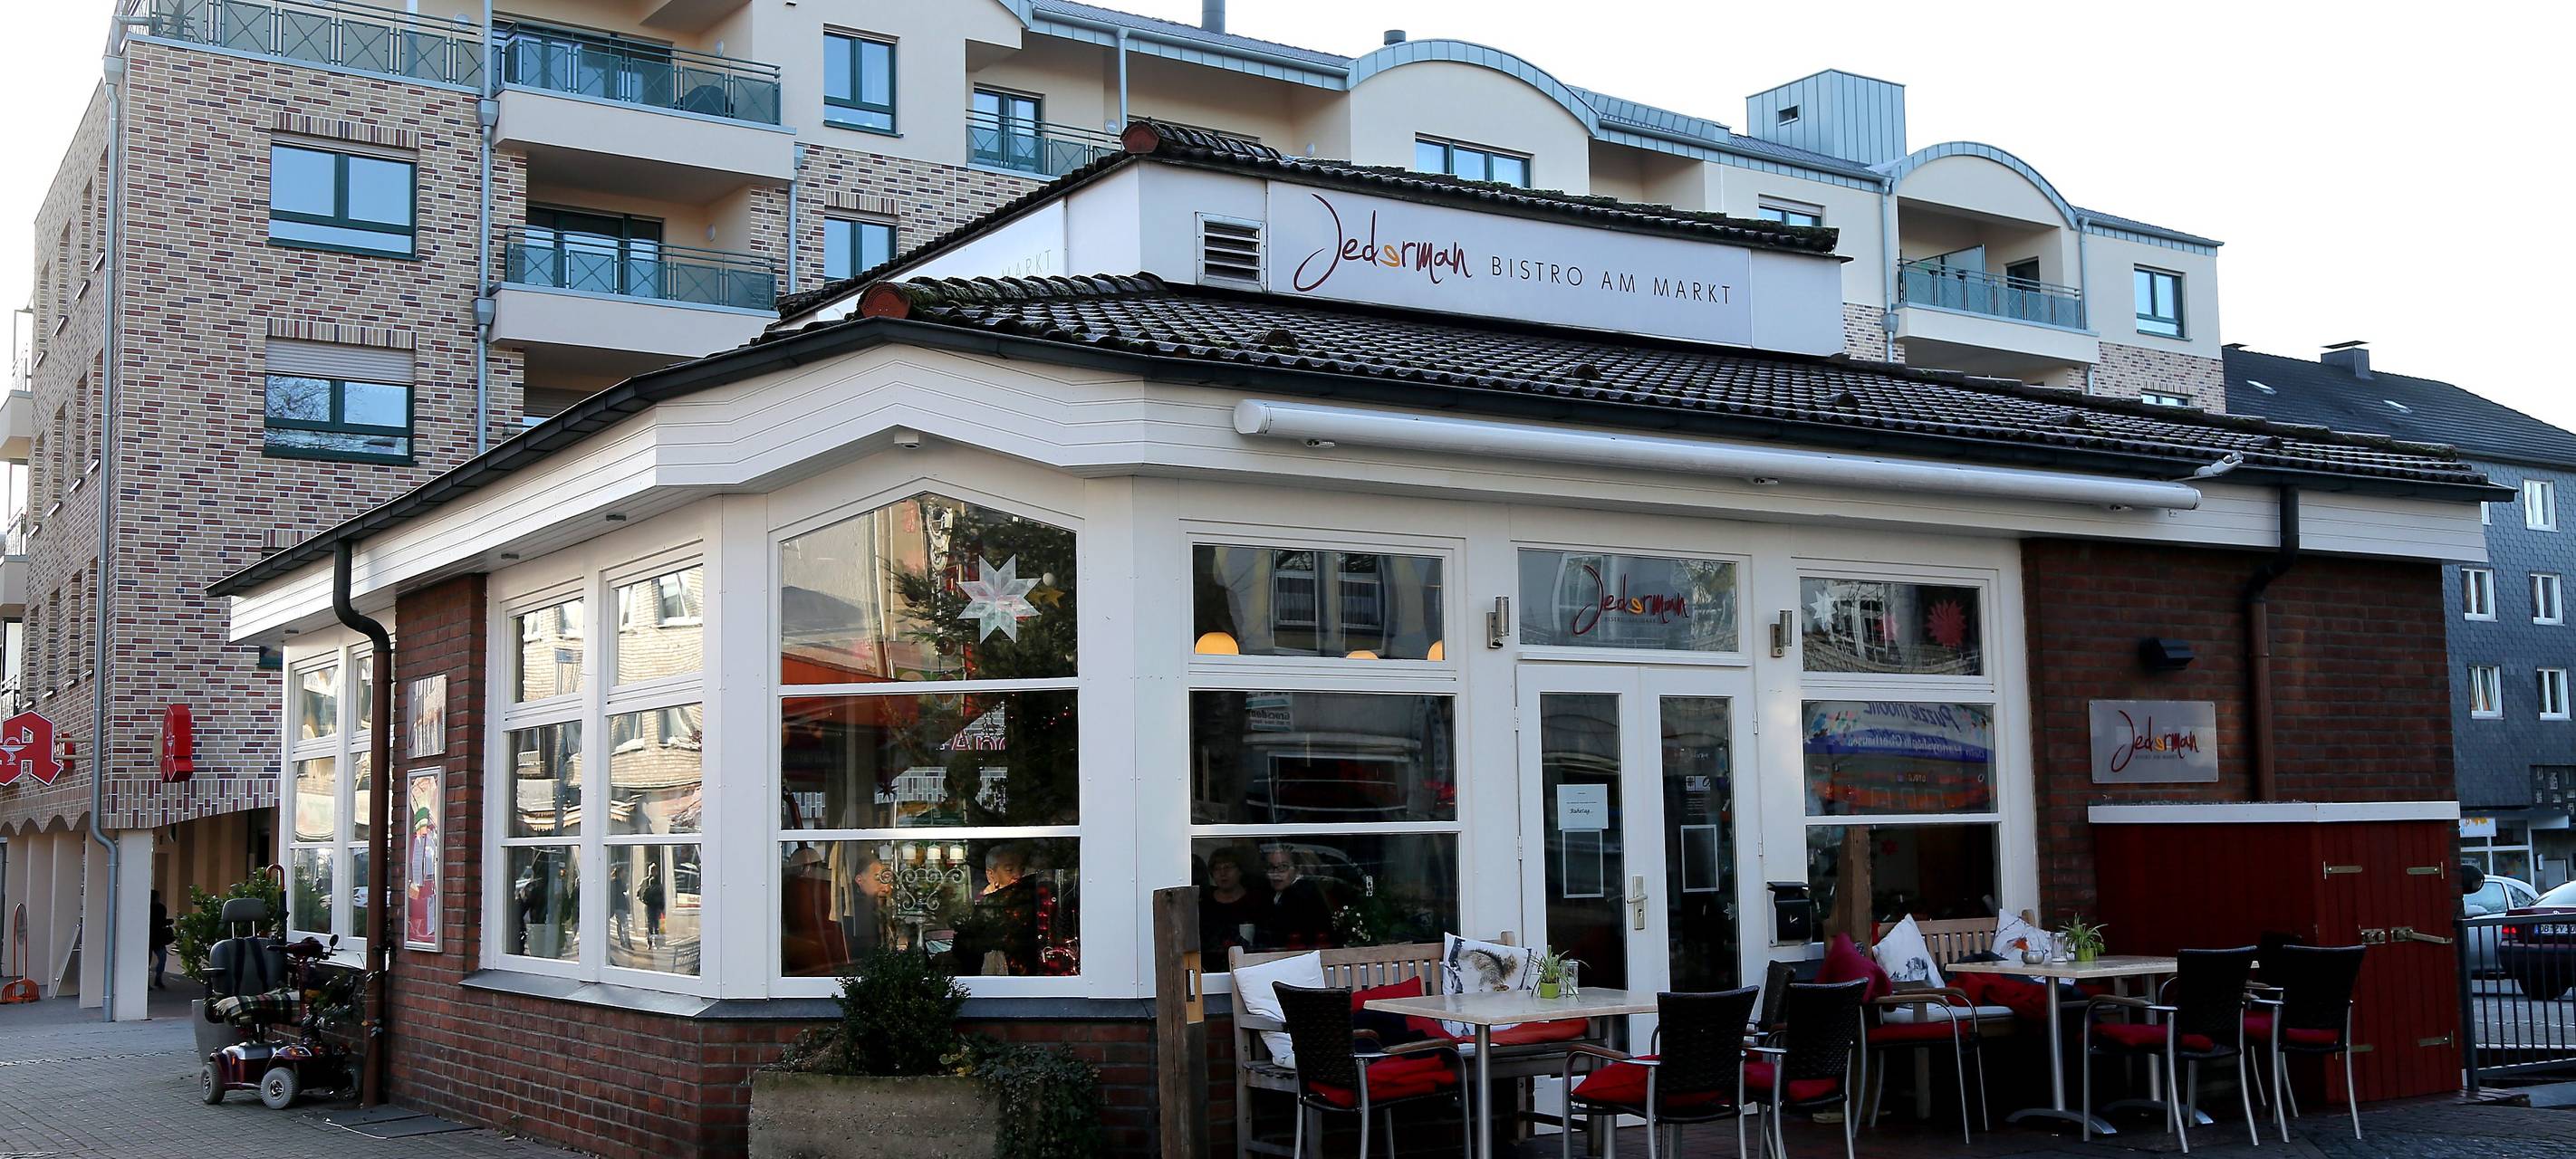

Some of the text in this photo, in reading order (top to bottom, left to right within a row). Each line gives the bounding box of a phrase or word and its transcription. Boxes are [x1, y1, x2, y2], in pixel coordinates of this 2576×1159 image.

[1293, 193, 1731, 304] Jederman BISTRO AM MARKT
[1572, 565, 1689, 635] Jederman
[2110, 710, 2199, 772] Jederman
